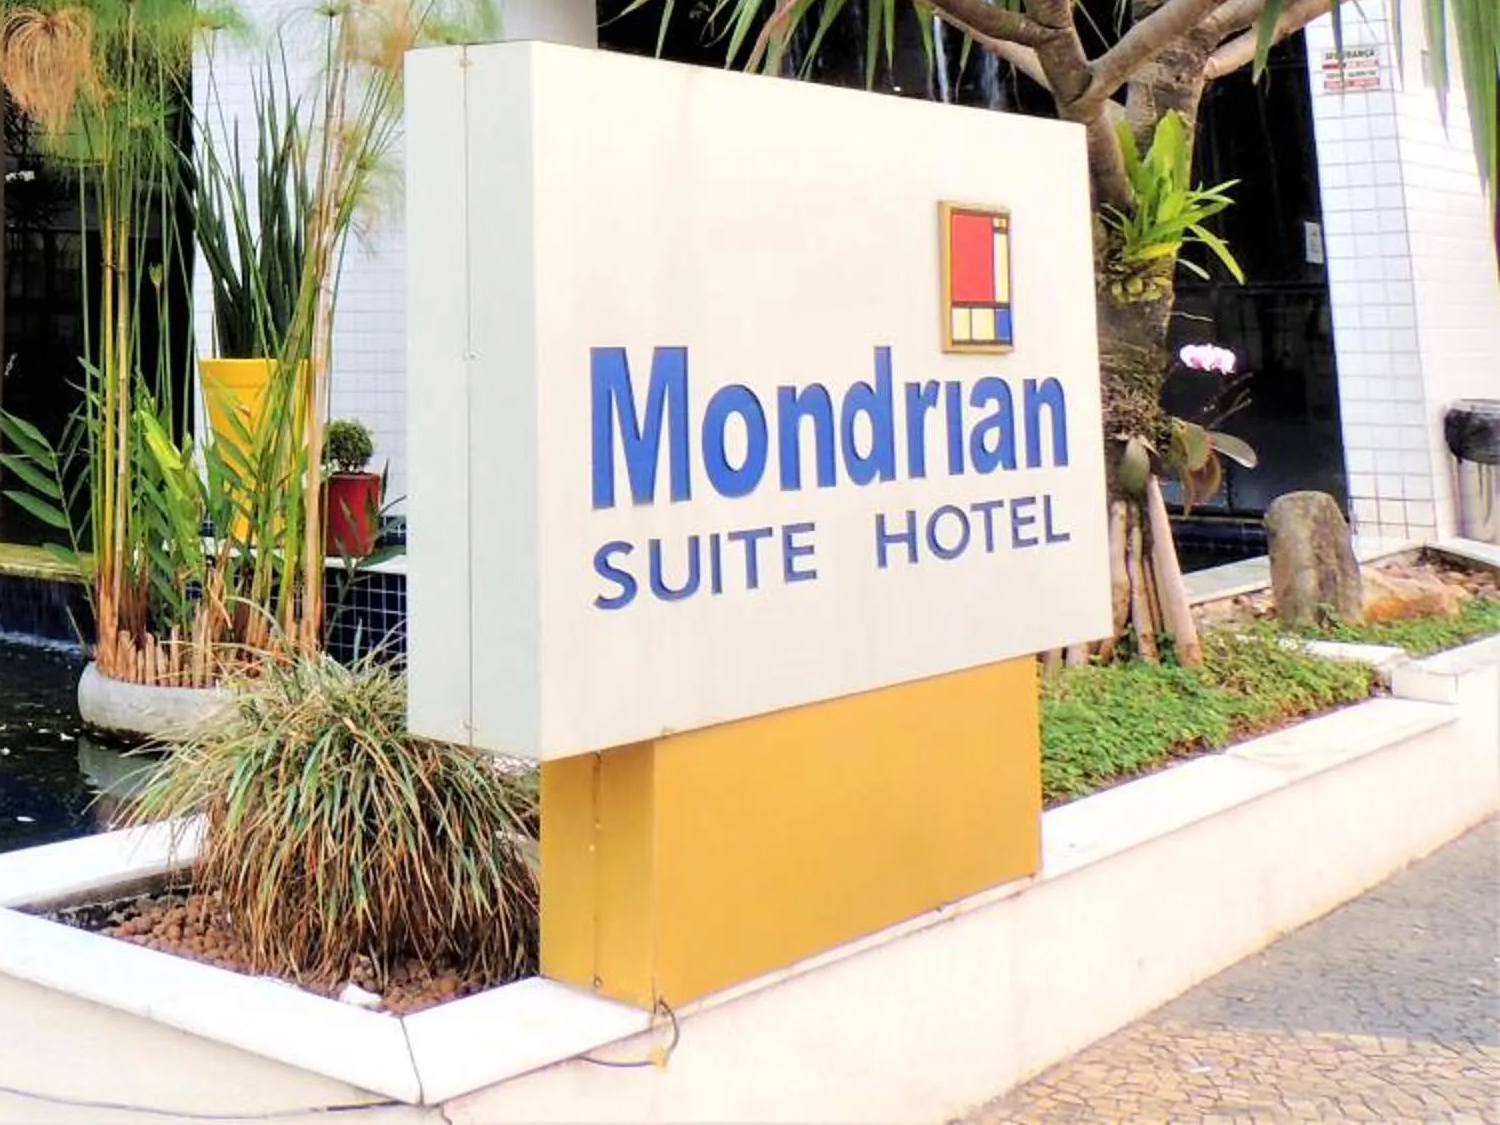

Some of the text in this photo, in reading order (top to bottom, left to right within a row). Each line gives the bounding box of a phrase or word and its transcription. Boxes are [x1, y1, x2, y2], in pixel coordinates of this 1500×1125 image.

[590, 346, 1069, 510] Mondrian
[593, 494, 1071, 611] SUITE HOTEL
